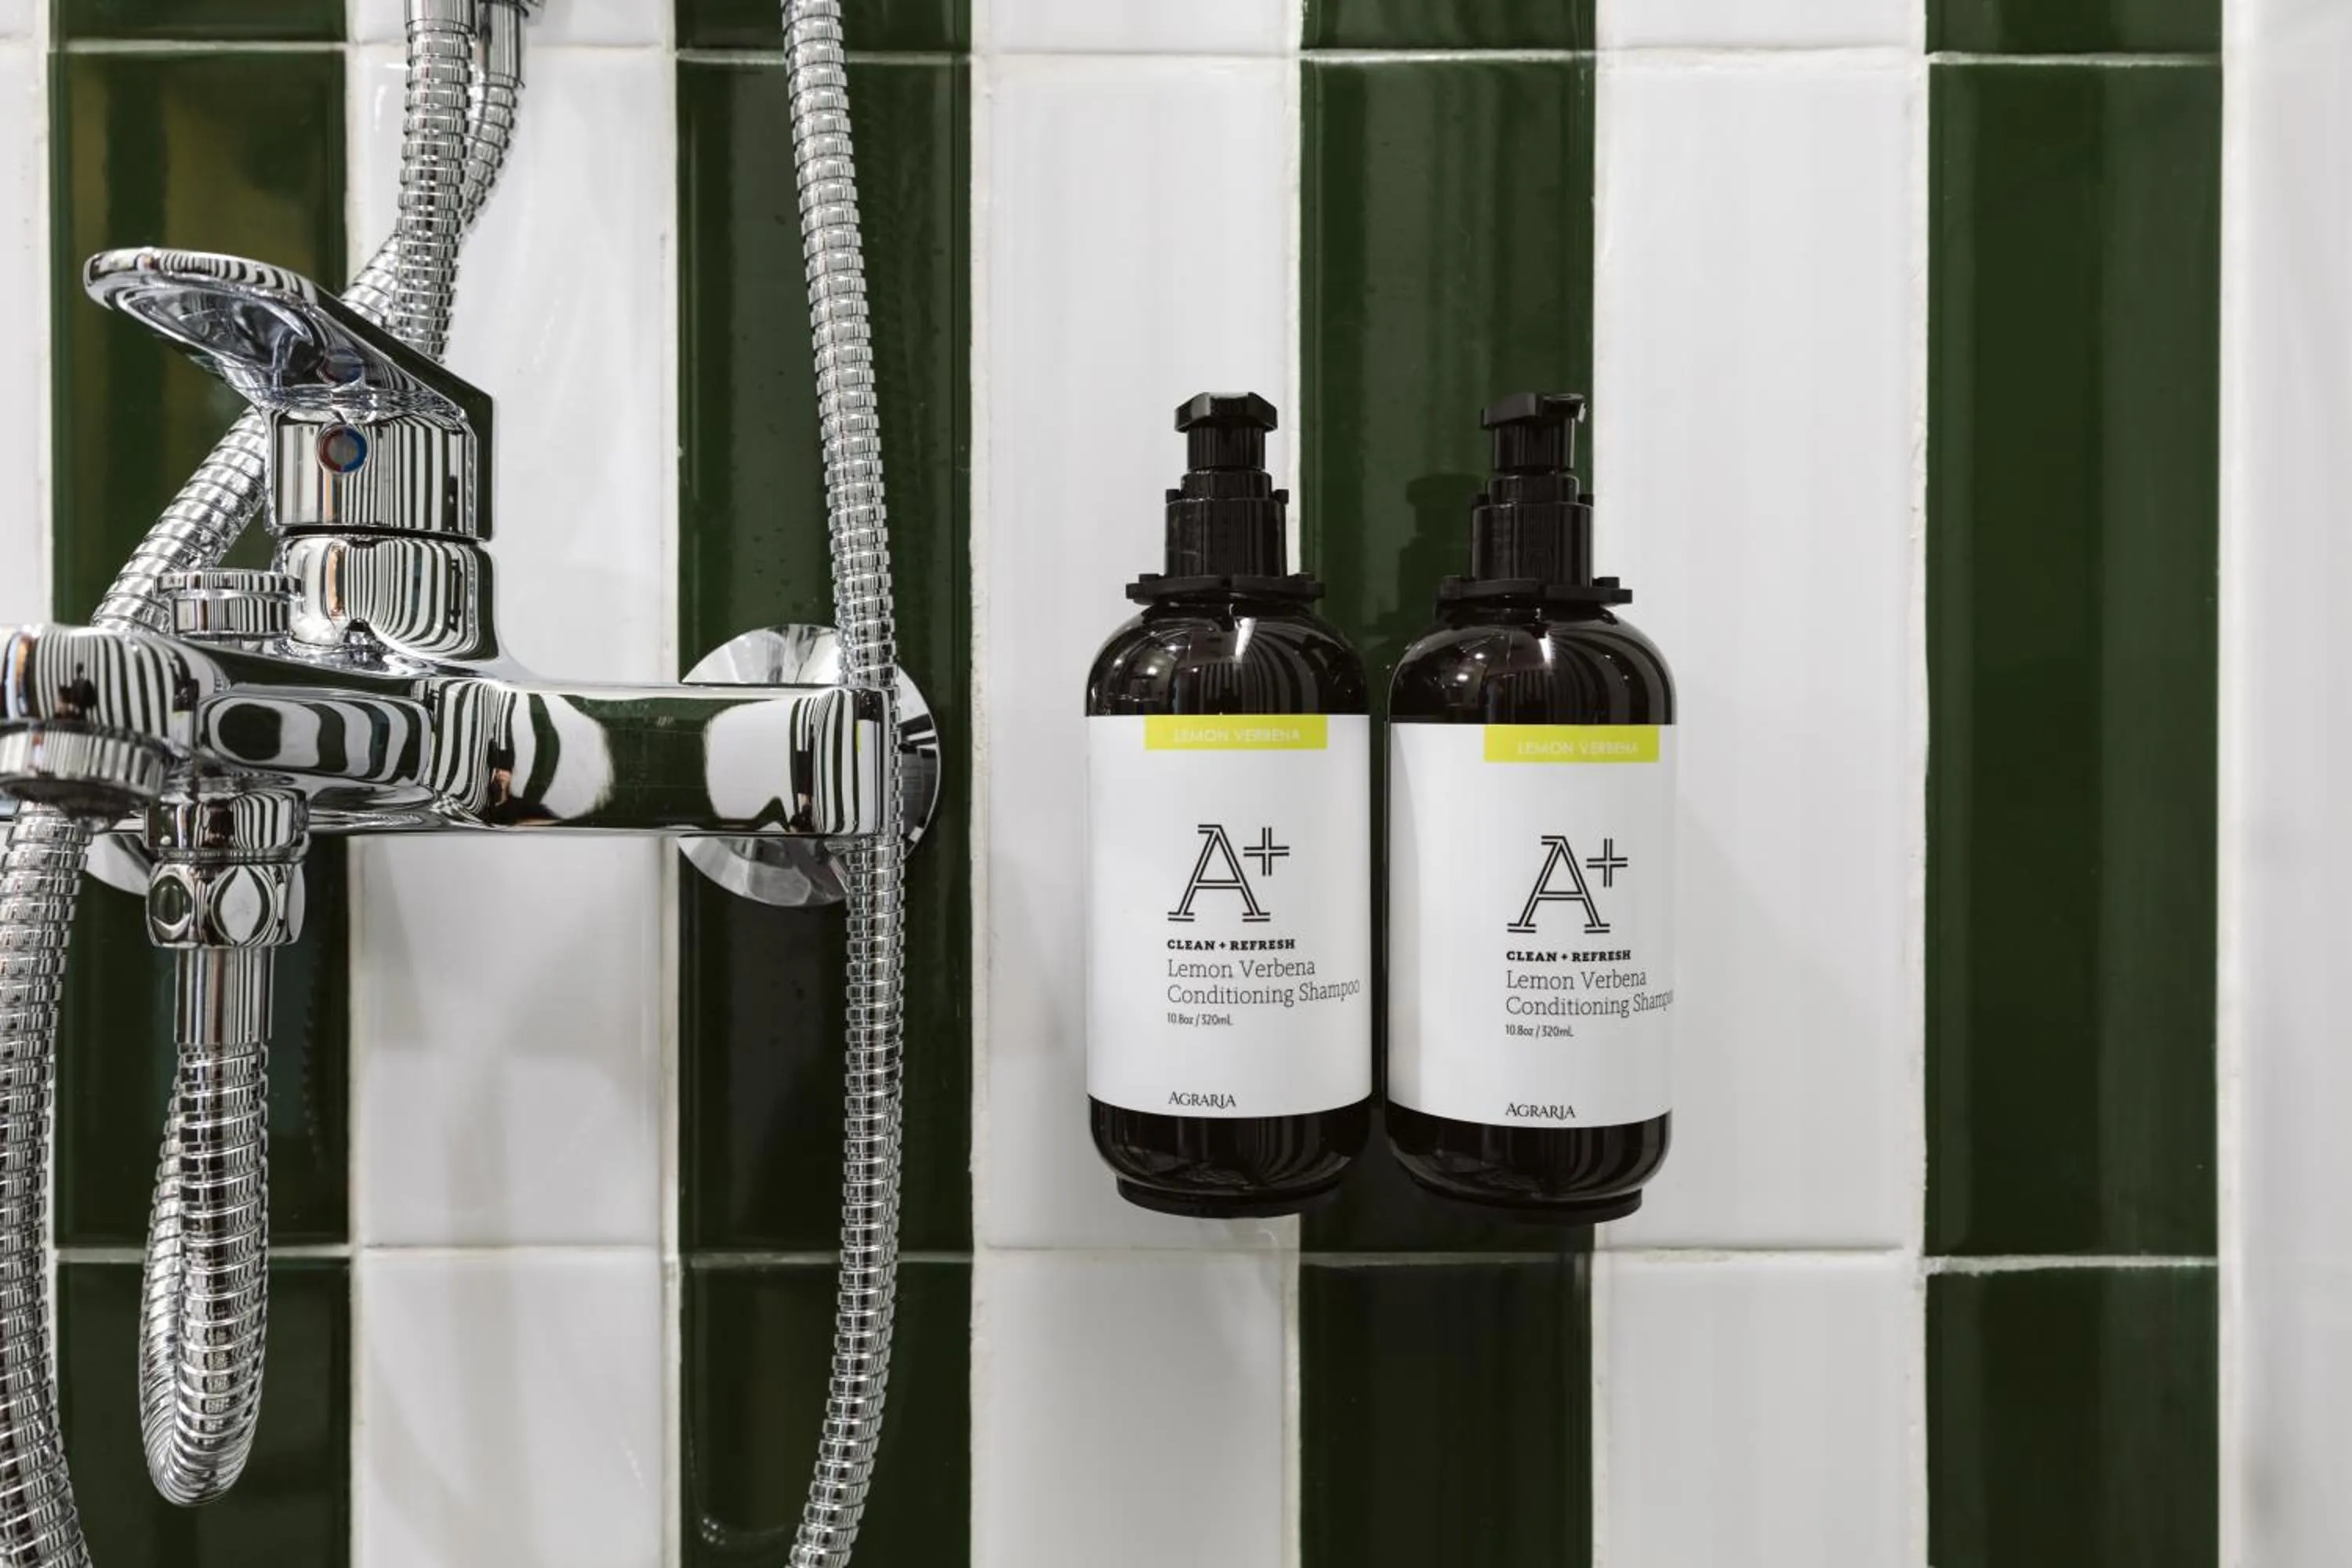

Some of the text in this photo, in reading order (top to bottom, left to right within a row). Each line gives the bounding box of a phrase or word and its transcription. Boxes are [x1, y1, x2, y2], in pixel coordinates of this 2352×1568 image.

[1167, 825, 1290, 922] A+
[1507, 836, 1628, 933] A+
[1167, 939, 1214, 950] CLEAN
[1229, 939, 1295, 950] REFRESH
[1506, 951, 1556, 961] CLEAN
[1572, 950, 1631, 961] REFRESH
[1167, 958, 1316, 978] Lemon Verbena
[1507, 969, 1646, 989] Lemon Verbena
[1167, 978, 1360, 1007] Conditioning Shampoo
[1506, 989, 1673, 1018] Conditioning Shamp
[1542, 1025, 1573, 1036] 320mL
